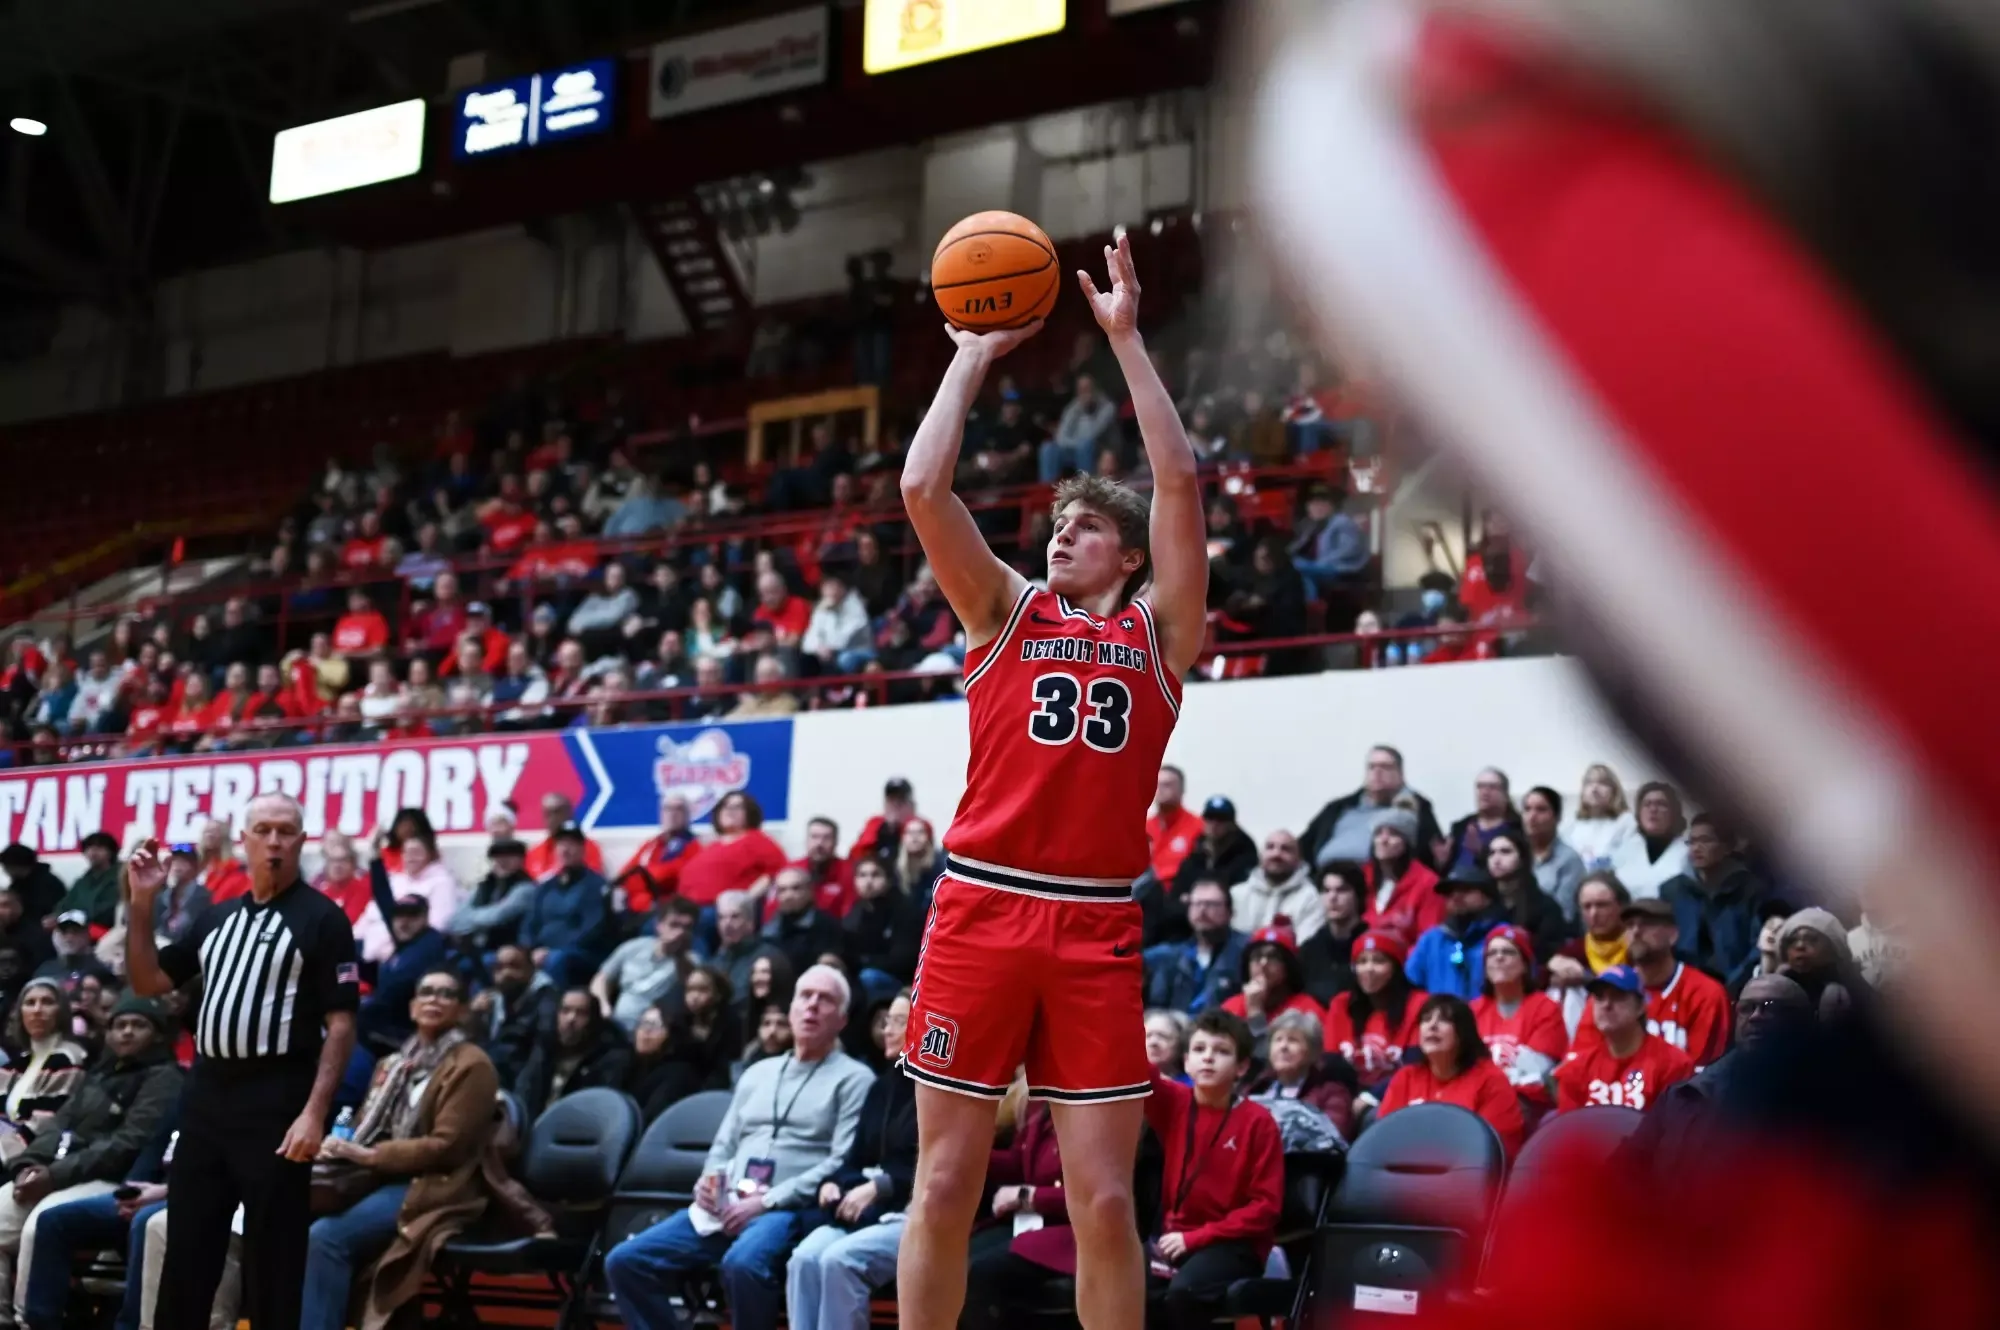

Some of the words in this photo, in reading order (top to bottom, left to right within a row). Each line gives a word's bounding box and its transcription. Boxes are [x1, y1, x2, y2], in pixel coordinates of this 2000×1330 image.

[965, 291, 1012, 314] EVO
[1021, 637, 1094, 662] DETROIT
[1097, 642, 1147, 673] MERCY
[1028, 672, 1132, 753] 33
[0, 773, 107, 851] TAN
